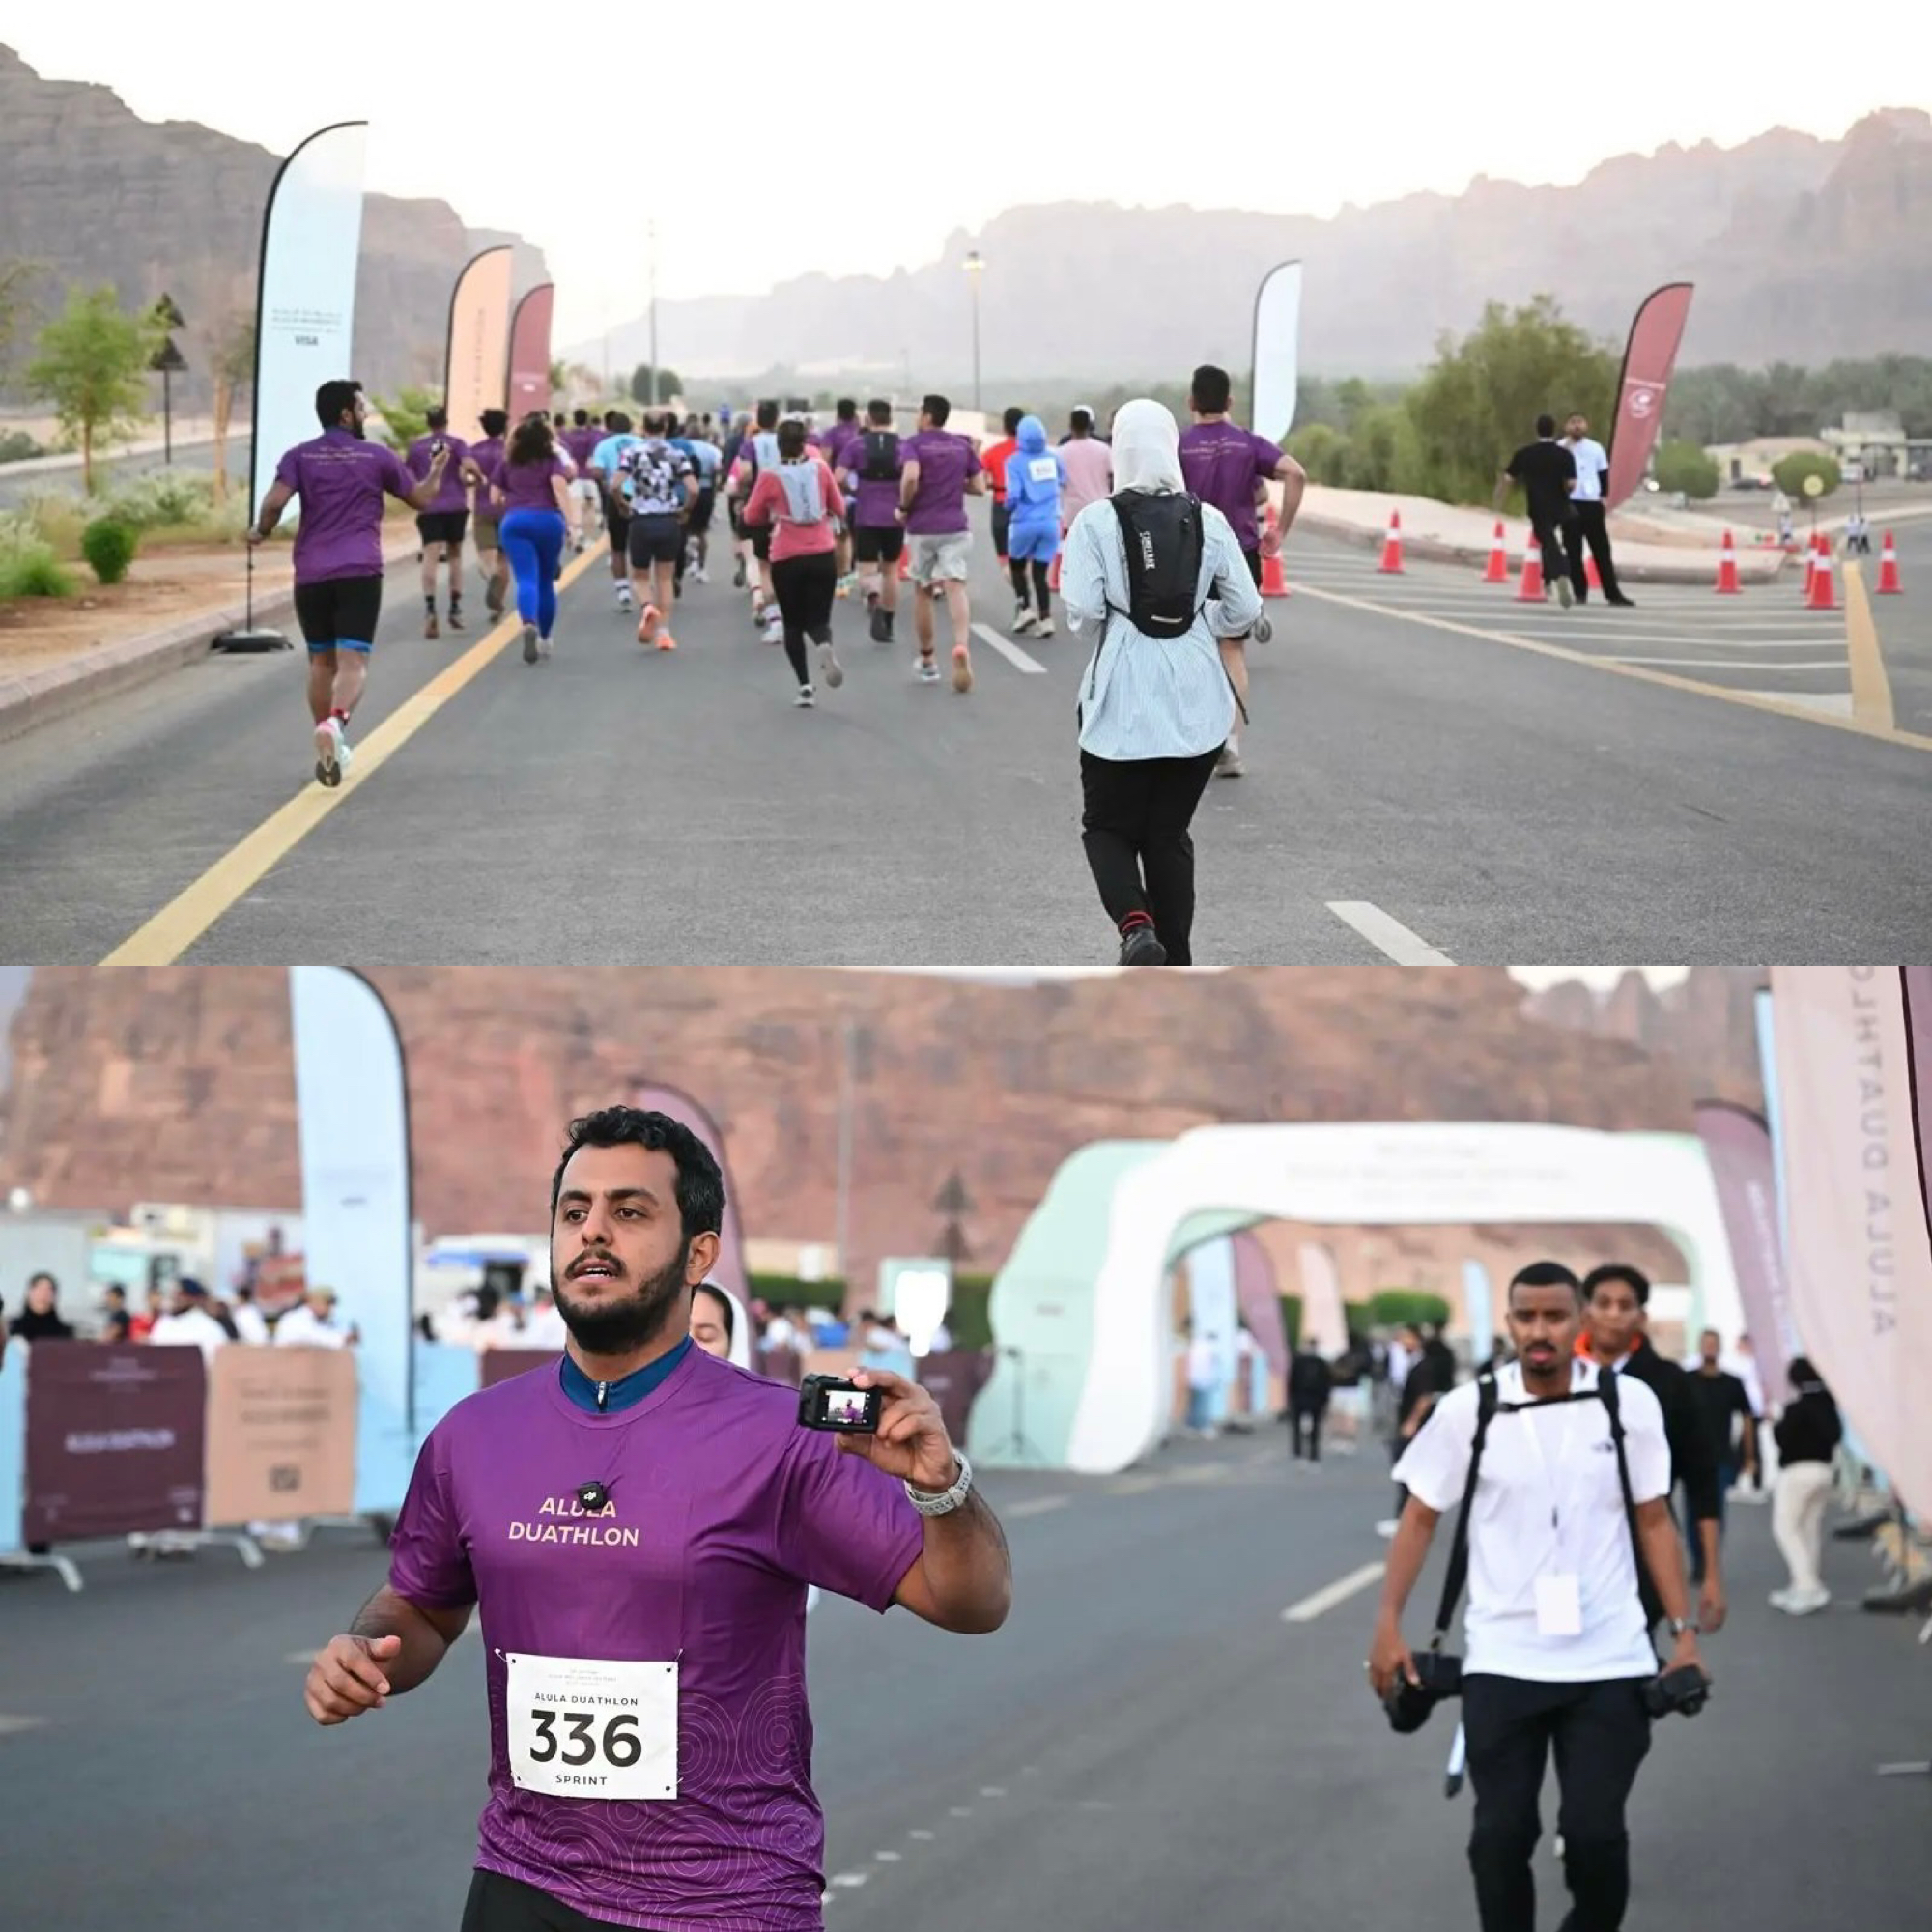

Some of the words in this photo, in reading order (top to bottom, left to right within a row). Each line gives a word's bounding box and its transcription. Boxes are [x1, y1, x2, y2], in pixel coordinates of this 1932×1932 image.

[508, 1521, 639, 1547] DUATHLON
[534, 1692, 567, 1703] ALULA
[571, 1695, 639, 1707] DUATHLON
[529, 1709, 642, 1768] 336
[555, 1775, 608, 1786] SPRINT
